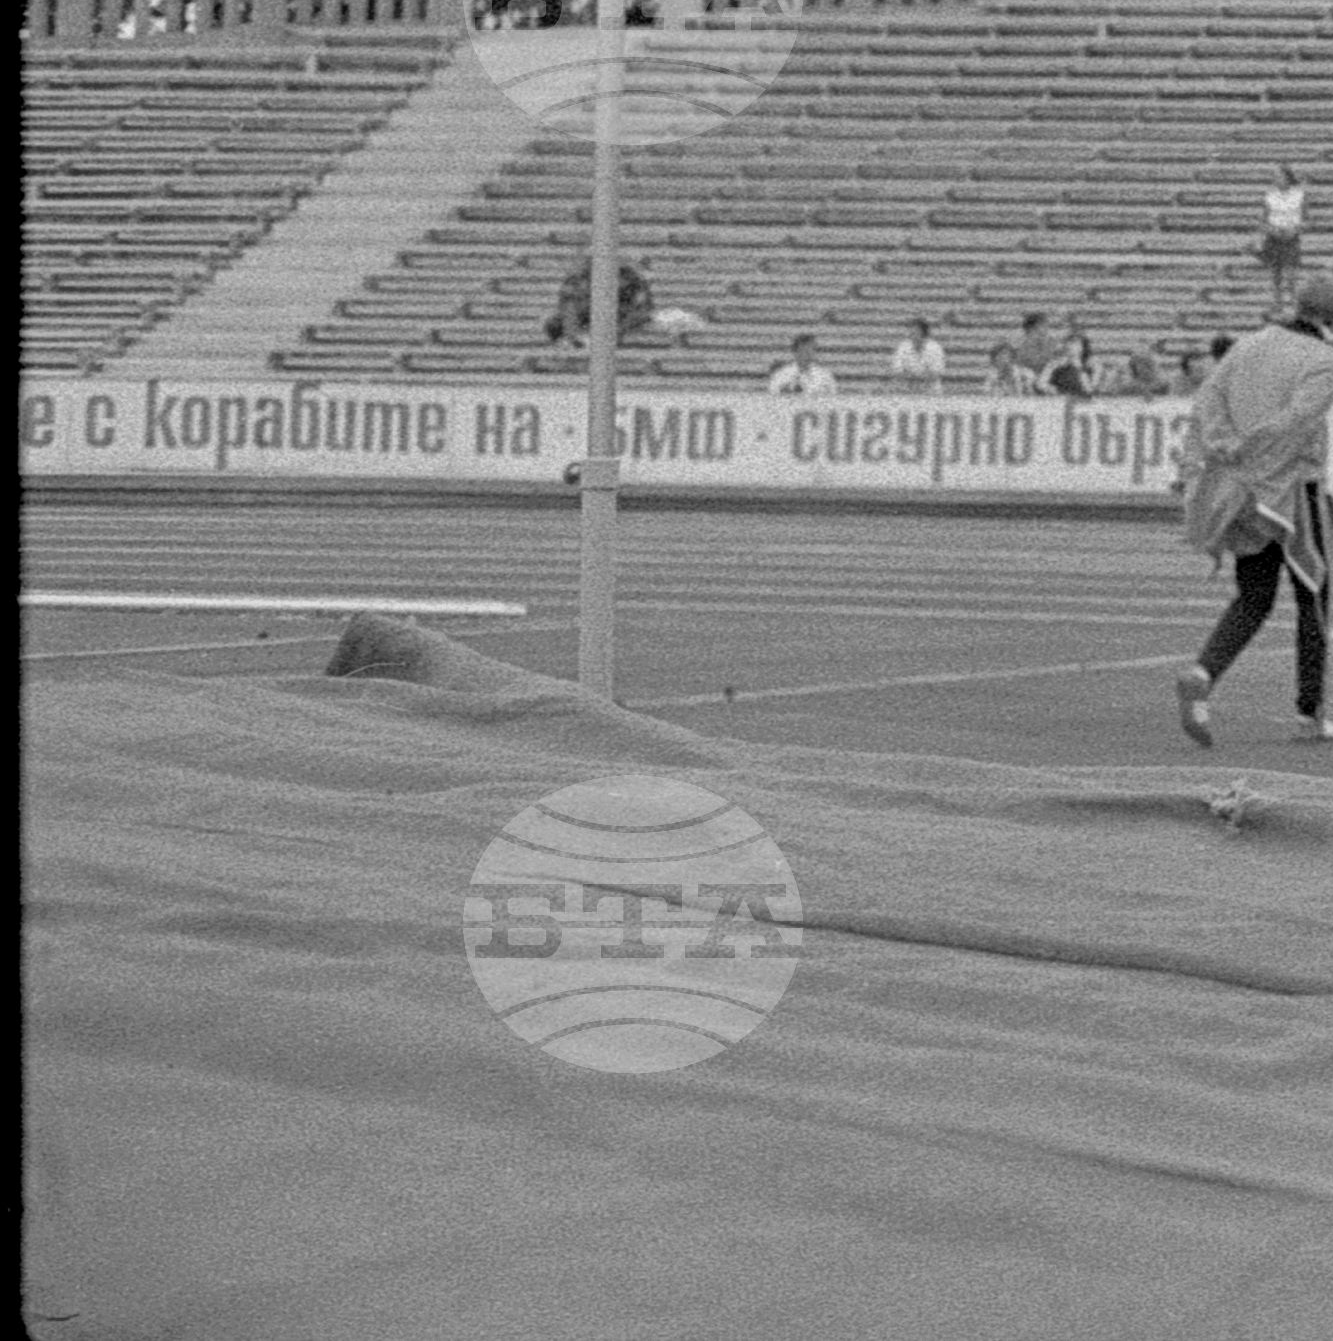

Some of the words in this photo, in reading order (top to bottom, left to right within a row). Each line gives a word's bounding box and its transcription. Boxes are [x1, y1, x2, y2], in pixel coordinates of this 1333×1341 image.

[86, 395, 116, 448] с
[145, 378, 447, 470] корабите
[477, 403, 540, 456] на
[791, 410, 1034, 481] сигурно
